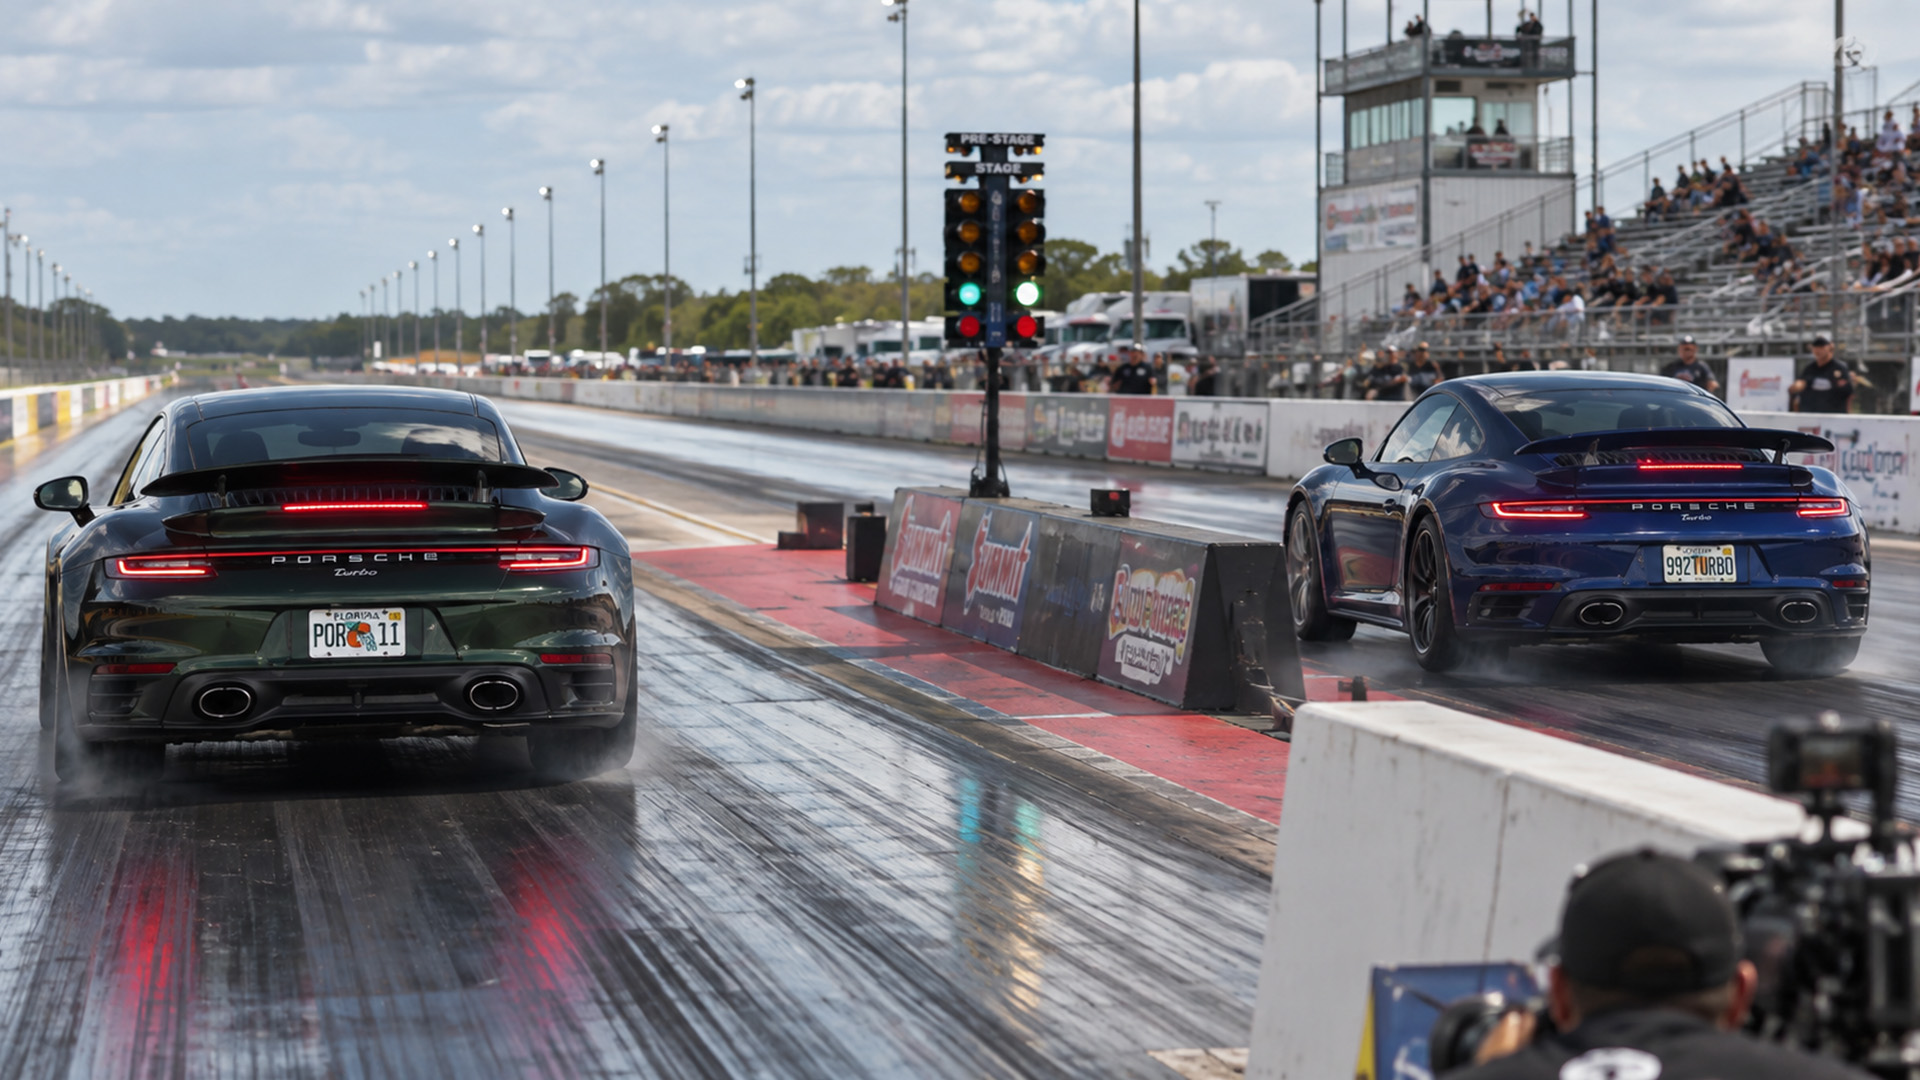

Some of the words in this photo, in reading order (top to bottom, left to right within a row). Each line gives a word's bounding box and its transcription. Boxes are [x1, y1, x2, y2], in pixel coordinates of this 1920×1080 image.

[960, 133, 1035, 145] PRE-STAGE
[975, 162, 1022, 174] STAGE
[1632, 502, 1755, 511] PORSCHE
[271, 552, 438, 565] PORSCHE
[1666, 555, 1734, 576] 992TURBO
[334, 568, 378, 577] Turbo
[313, 623, 346, 648] POR
[378, 622, 401, 646] 11
